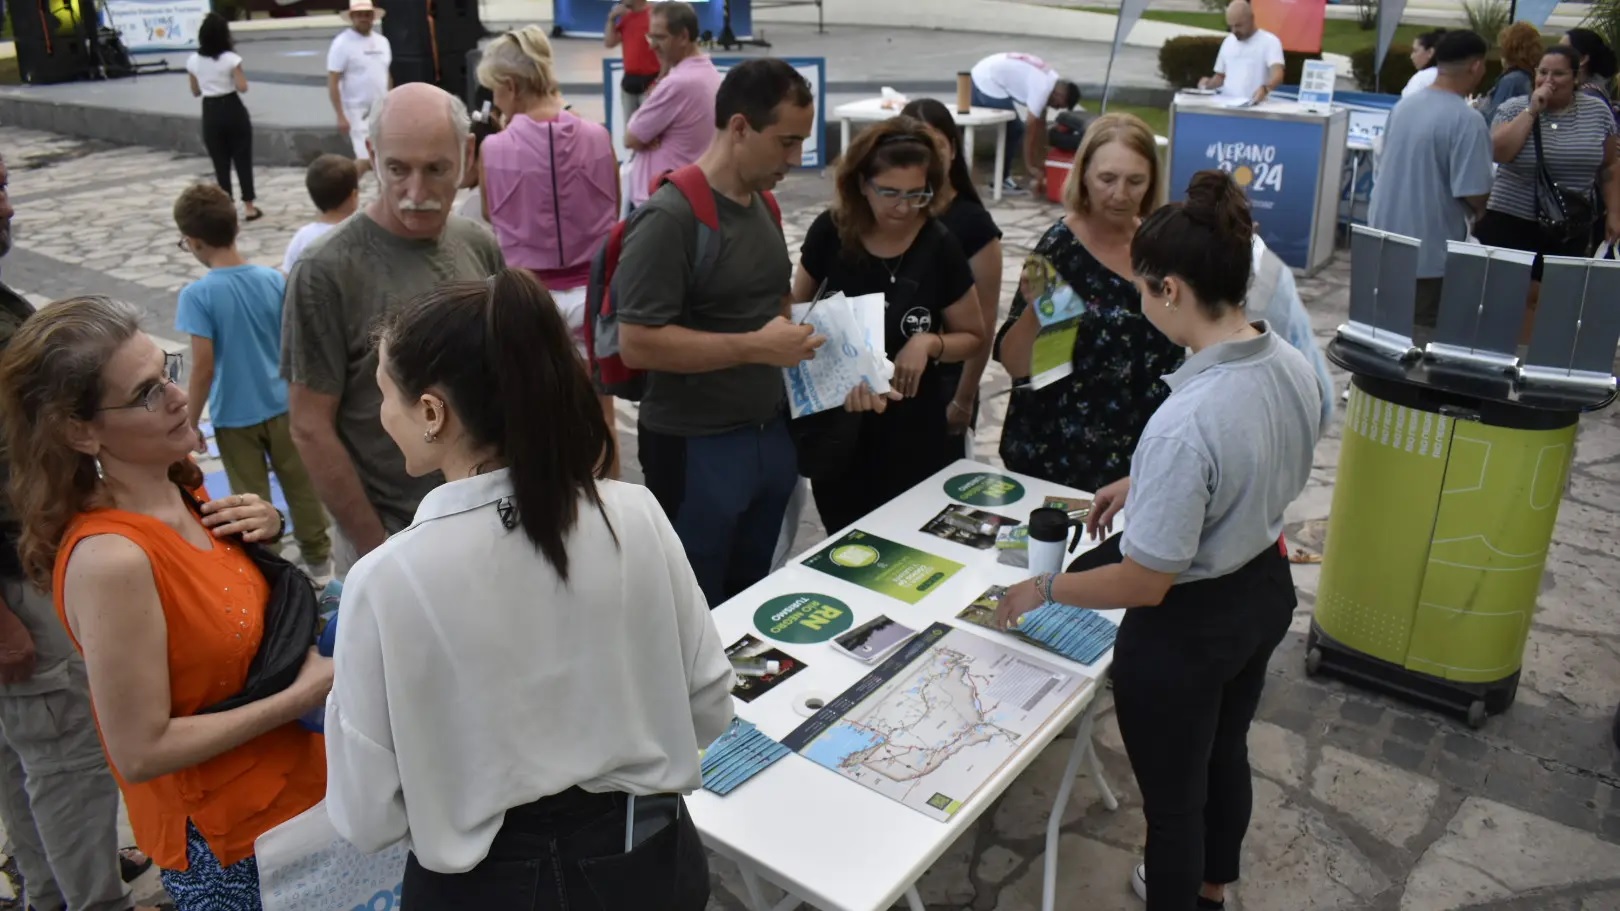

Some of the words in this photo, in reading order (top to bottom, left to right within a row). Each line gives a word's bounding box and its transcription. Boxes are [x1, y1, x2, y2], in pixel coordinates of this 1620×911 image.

[1206, 142, 1276, 163] #VERANO
[771, 597, 810, 621] TURISMO
[799, 605, 843, 631] RN
[770, 611, 804, 633] NEGRO
